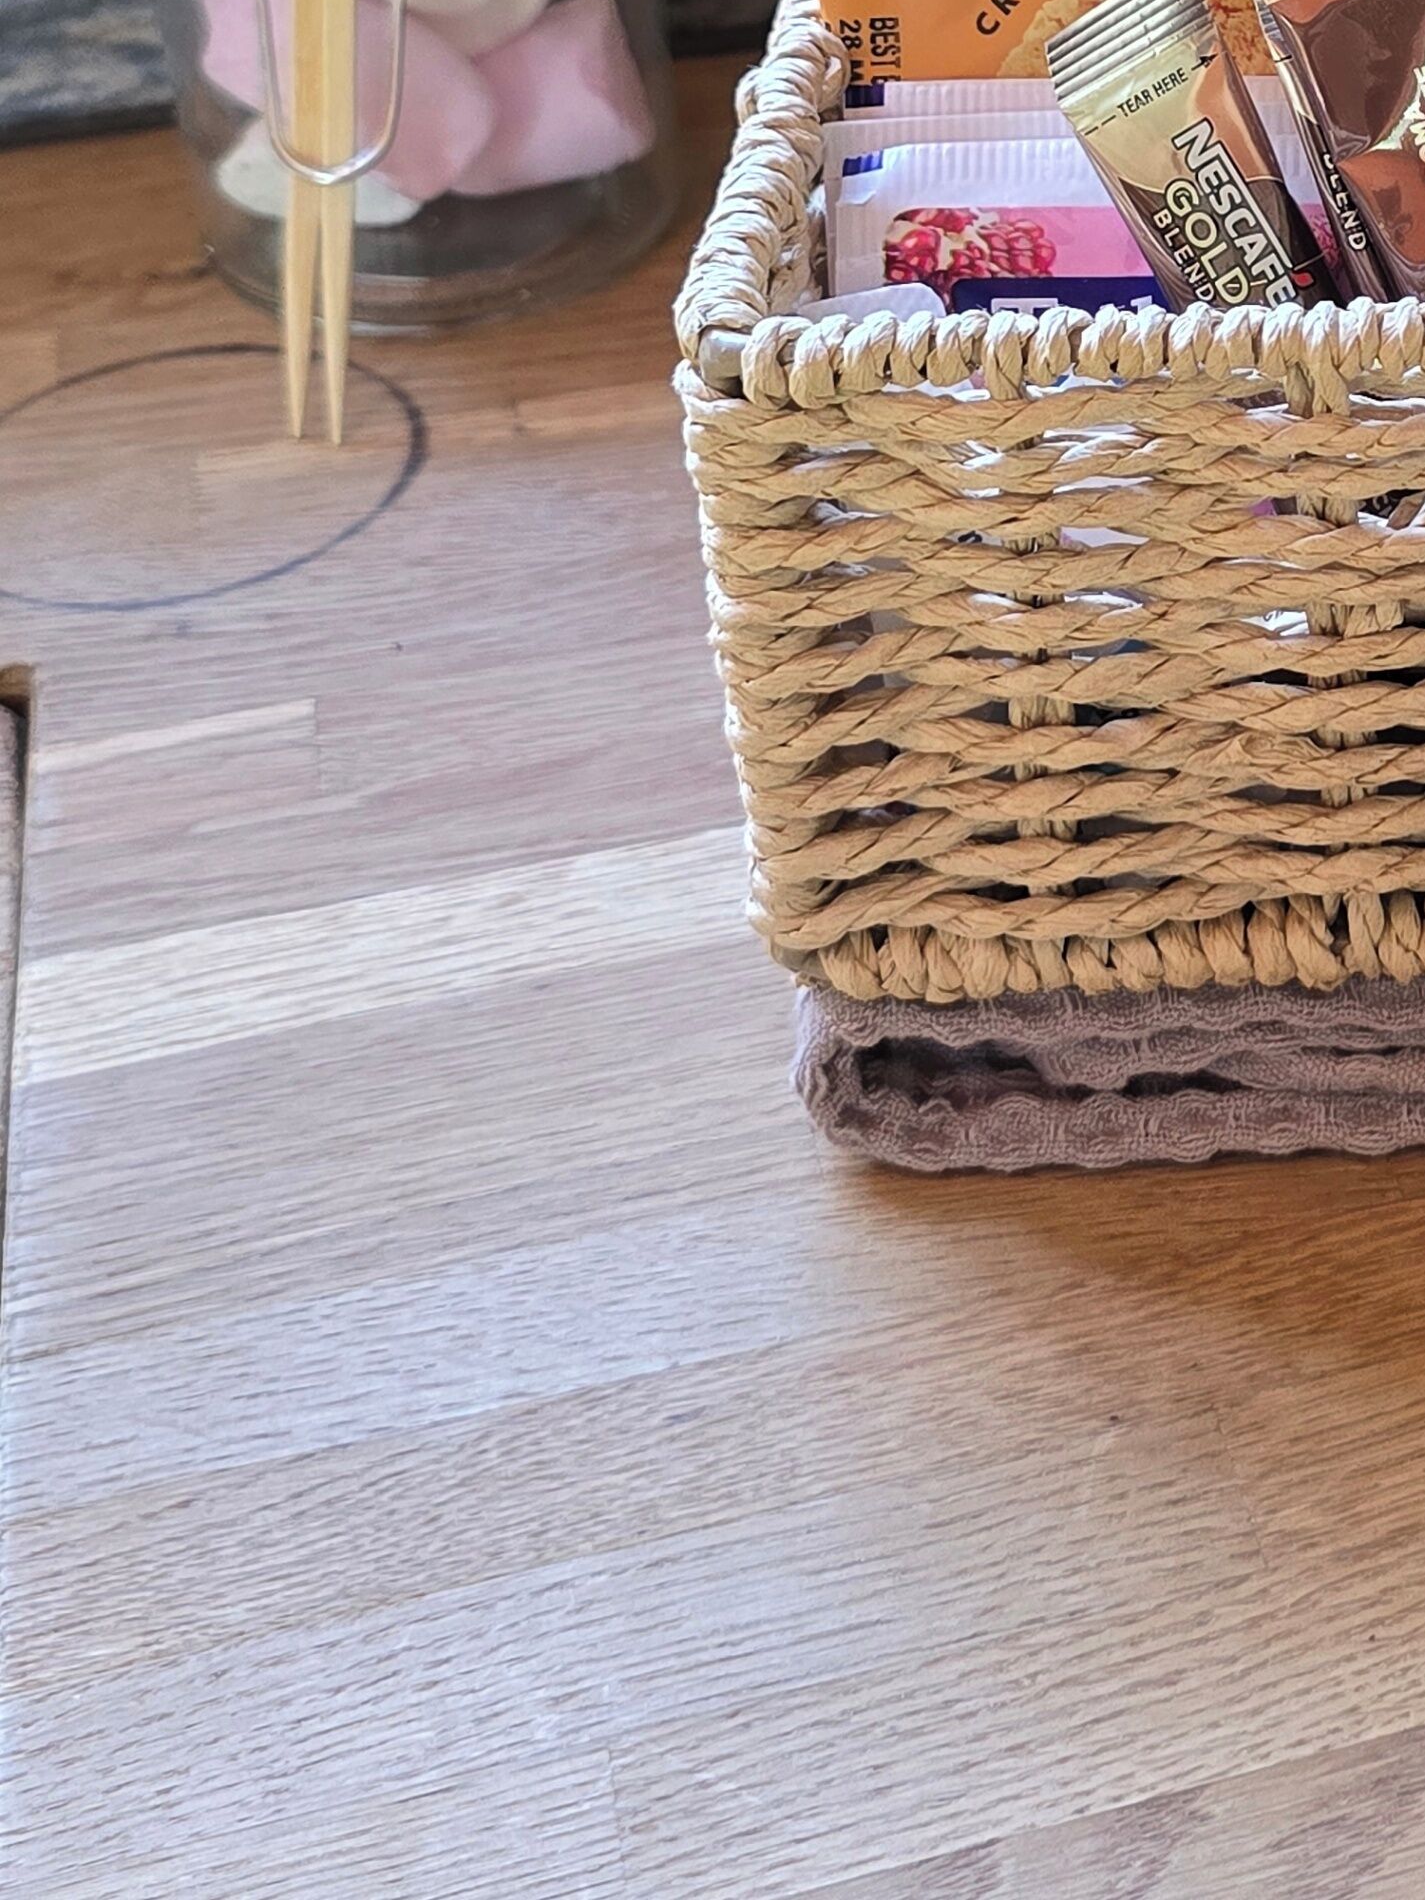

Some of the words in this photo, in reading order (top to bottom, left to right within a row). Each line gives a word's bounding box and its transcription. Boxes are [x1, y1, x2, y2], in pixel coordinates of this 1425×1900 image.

[869, 17, 901, 69] BEST
[1117, 88, 1154, 118] TEAR
[1151, 67, 1189, 98] HERE
[1153, 208, 1215, 301] BLEND
[1165, 179, 1250, 304] GOLD
